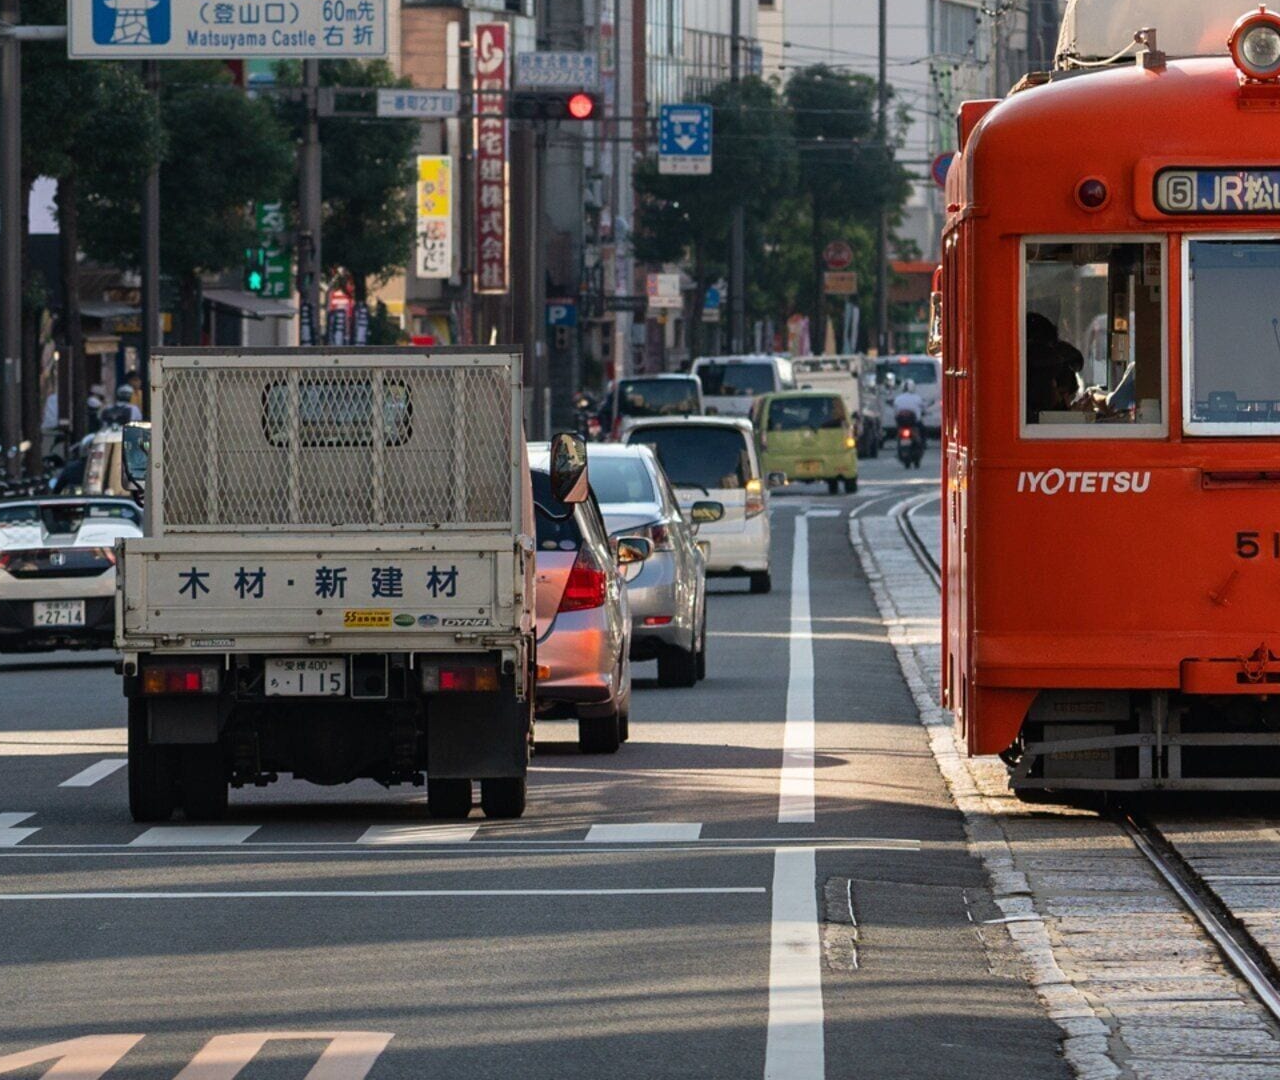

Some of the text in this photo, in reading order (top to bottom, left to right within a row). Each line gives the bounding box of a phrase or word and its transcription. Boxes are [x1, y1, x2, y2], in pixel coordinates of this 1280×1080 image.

[200, 2, 300, 25] （登山口）
[323, 0, 374, 22] 60m先
[187, 29, 316, 49] Matsuyama Castle
[323, 25, 374, 46] 右折
[1172, 181, 1188, 204] 5
[1017, 468, 1151, 496] IYOTETSU
[1235, 531, 1280, 559] 51
[177, 565, 460, 600] 木材・新建材
